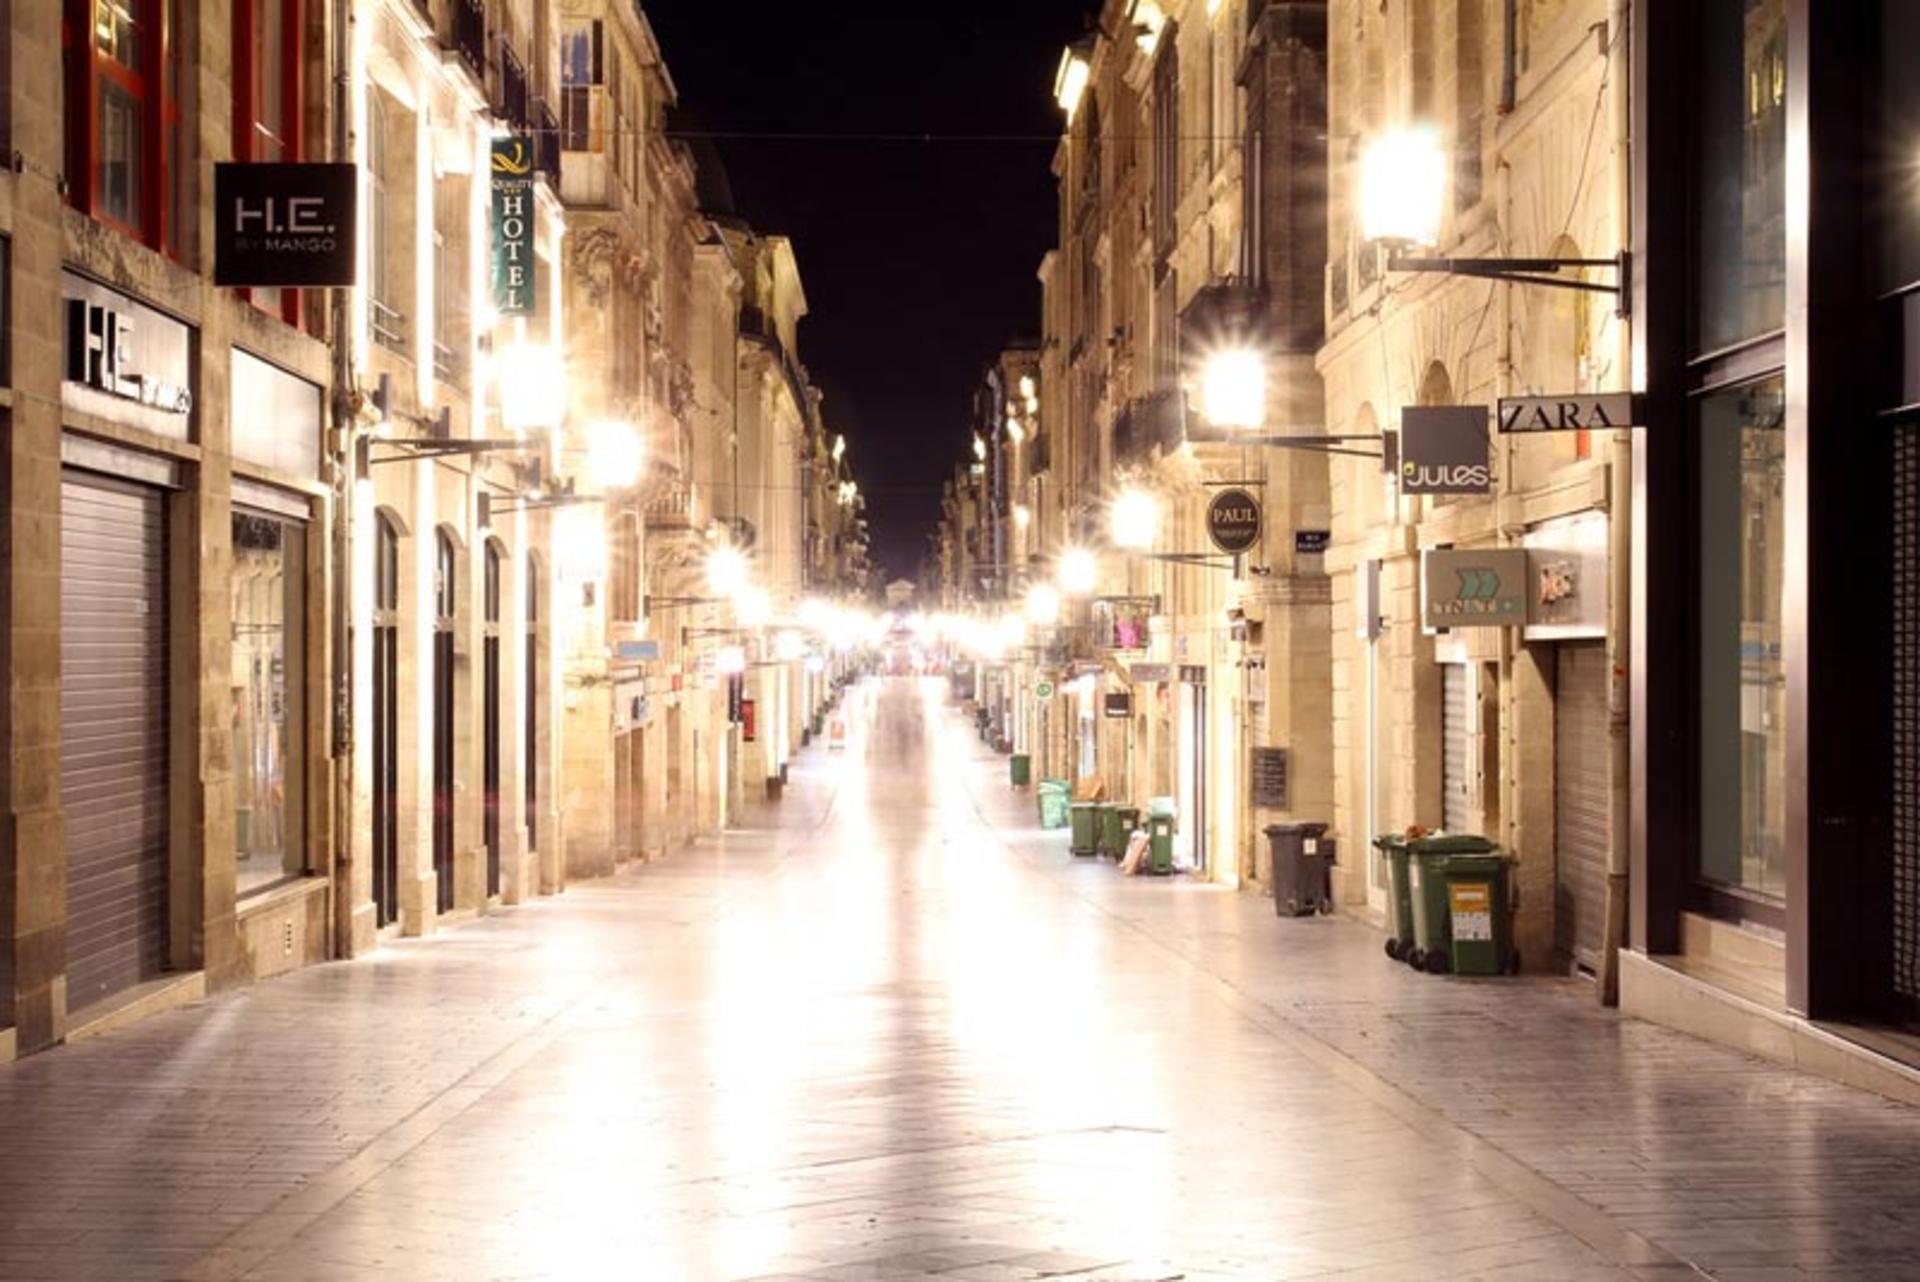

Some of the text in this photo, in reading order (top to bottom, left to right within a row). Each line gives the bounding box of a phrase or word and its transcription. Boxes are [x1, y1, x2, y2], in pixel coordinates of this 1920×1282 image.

[235, 196, 336, 233] H.E.
[265, 237, 337, 251] MANGO
[503, 196, 524, 308] HOTEL
[1501, 401, 1611, 432] ZARA
[1213, 508, 1256, 523] PAUL
